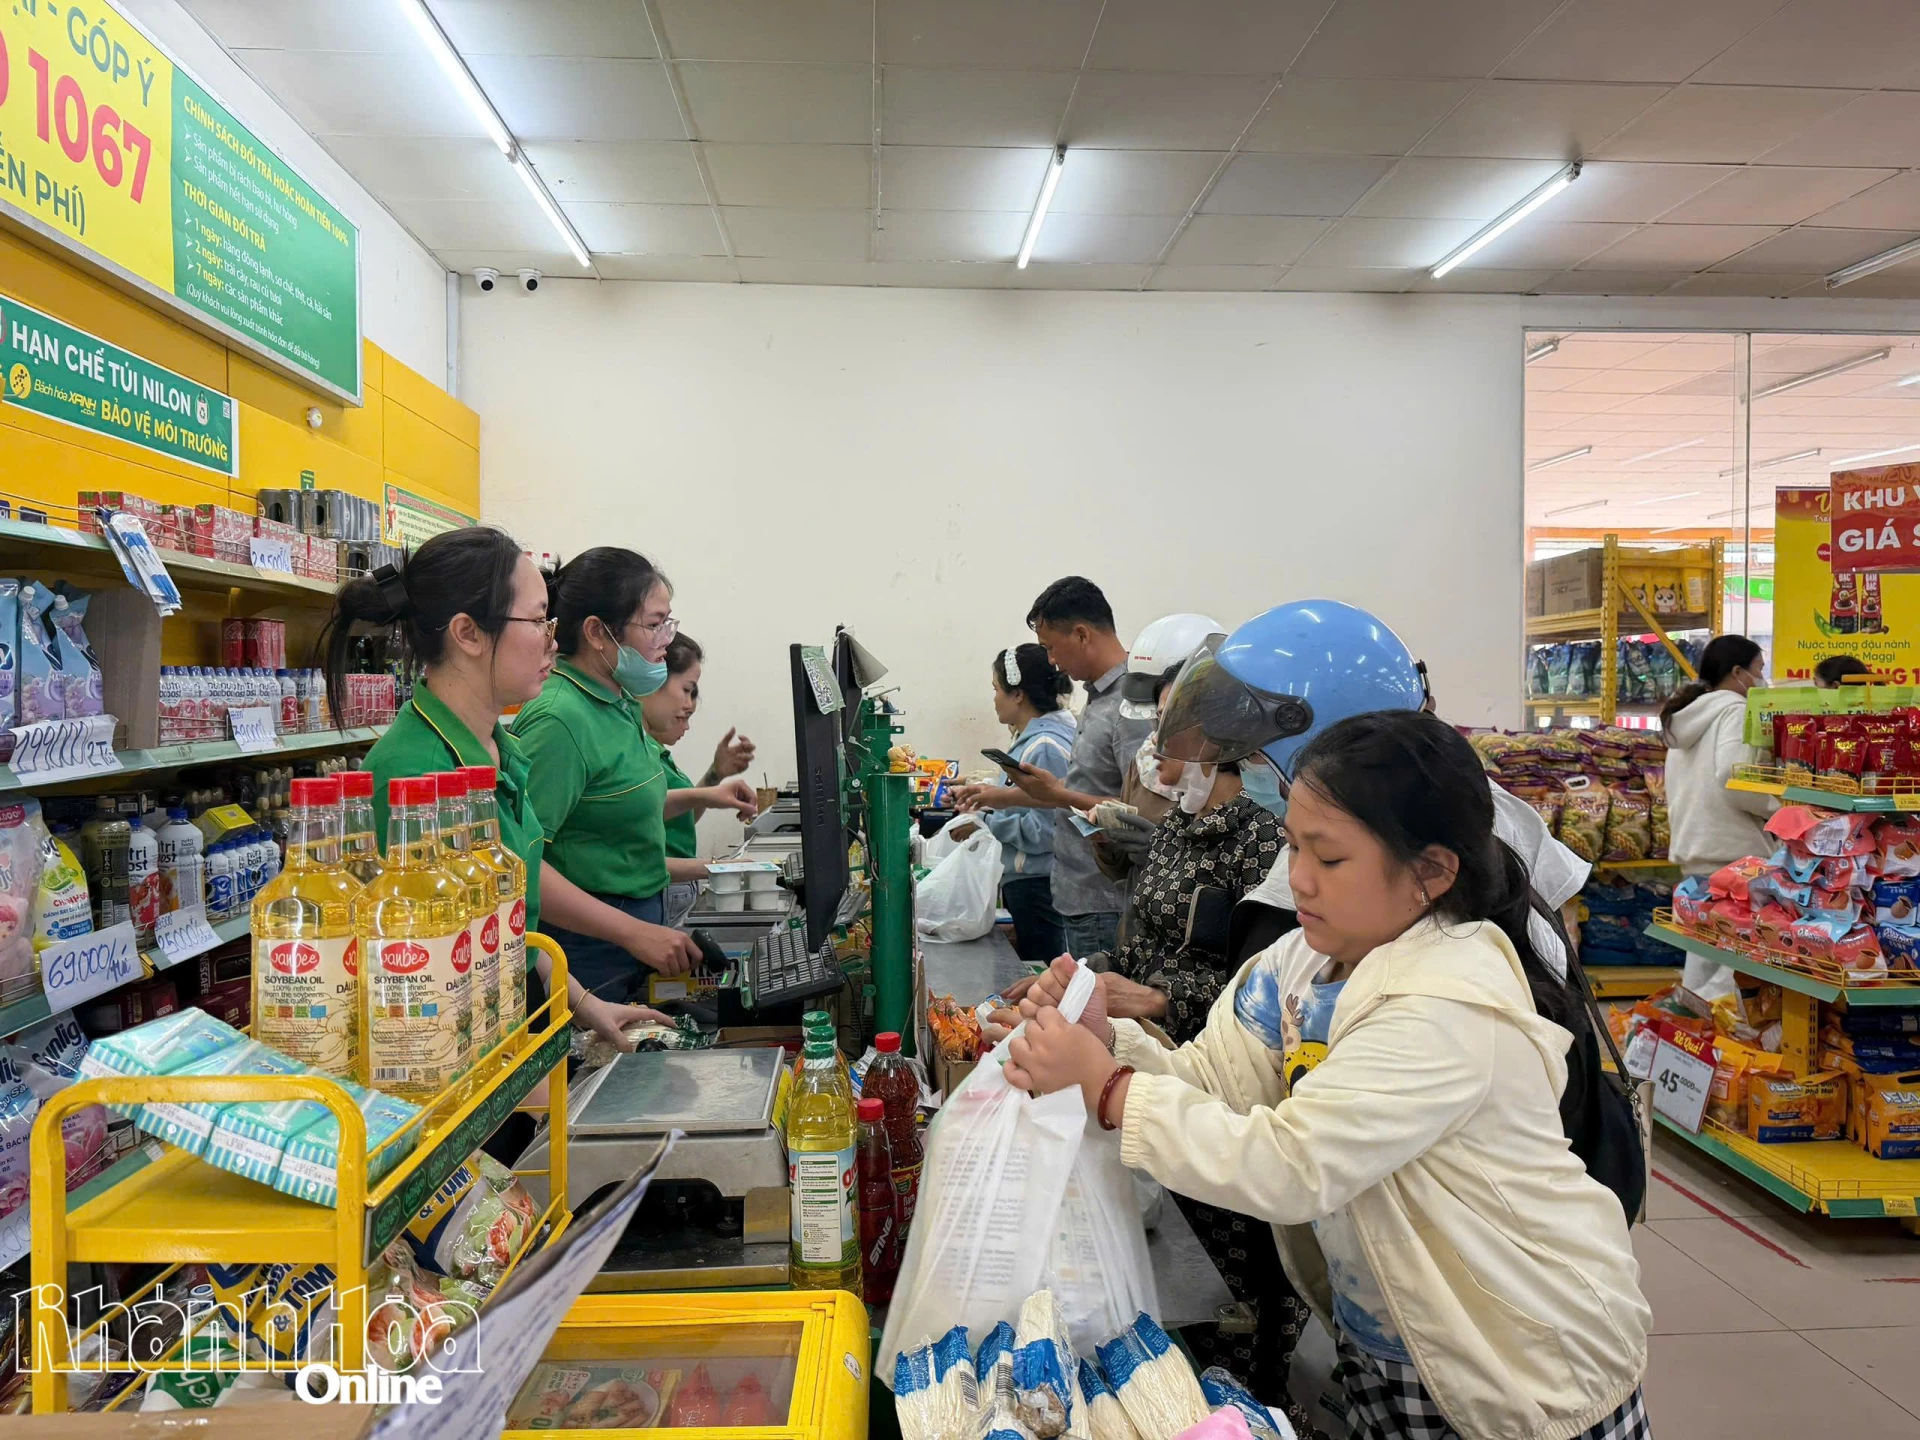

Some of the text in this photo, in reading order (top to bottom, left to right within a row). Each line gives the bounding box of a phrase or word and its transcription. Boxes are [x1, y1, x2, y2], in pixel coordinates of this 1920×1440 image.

[67, 6, 130, 84] GÓP
[137, 57, 155, 108] Ý
[28, 46, 151, 204] 1067
[184, 95, 215, 132] CHÍNH
[215, 124, 239, 154] SÁCH
[240, 143, 257, 169] ĐỔI
[193, 133, 207, 153] Sản
[208, 143, 229, 172] phẩm
[193, 156, 207, 177] Sản
[208, 166, 229, 194] phẩm
[35, 169, 86, 236] PHÍ)
[183, 180, 207, 212] THỜI
[208, 200, 232, 228] GIAN
[195, 240, 201, 255] 2
[201, 246, 224, 270] ngày:
[200, 223, 223, 248] ngày:
[223, 236, 241, 261] hàng
[241, 250, 259, 275] đông
[196, 263, 202, 276] 7
[202, 268, 225, 293] ngày:
[12, 320, 192, 416] HẠN CHẾ TÚI NILON
[34, 379, 97, 410] Bách hóa XANH
[101, 398, 229, 463] BẢO VỆ MÔI TRƯỜNG
[1843, 485, 1905, 511] KHU
[1838, 519, 1901, 553] GIÁ
[1797, 638, 1911, 652] Nước tương đậu nành
[1863, 651, 1896, 663] Maggi
[815, 765, 826, 828] PHILIPS
[264, 976, 325, 985] SOYBEAN OIL
[264, 991, 280, 999] from
[281, 991, 292, 999] the
[374, 975, 436, 985] SOYBEAN OIL
[1683, 1036, 1705, 1056] Quá!
[869, 1215, 893, 1268] STING
